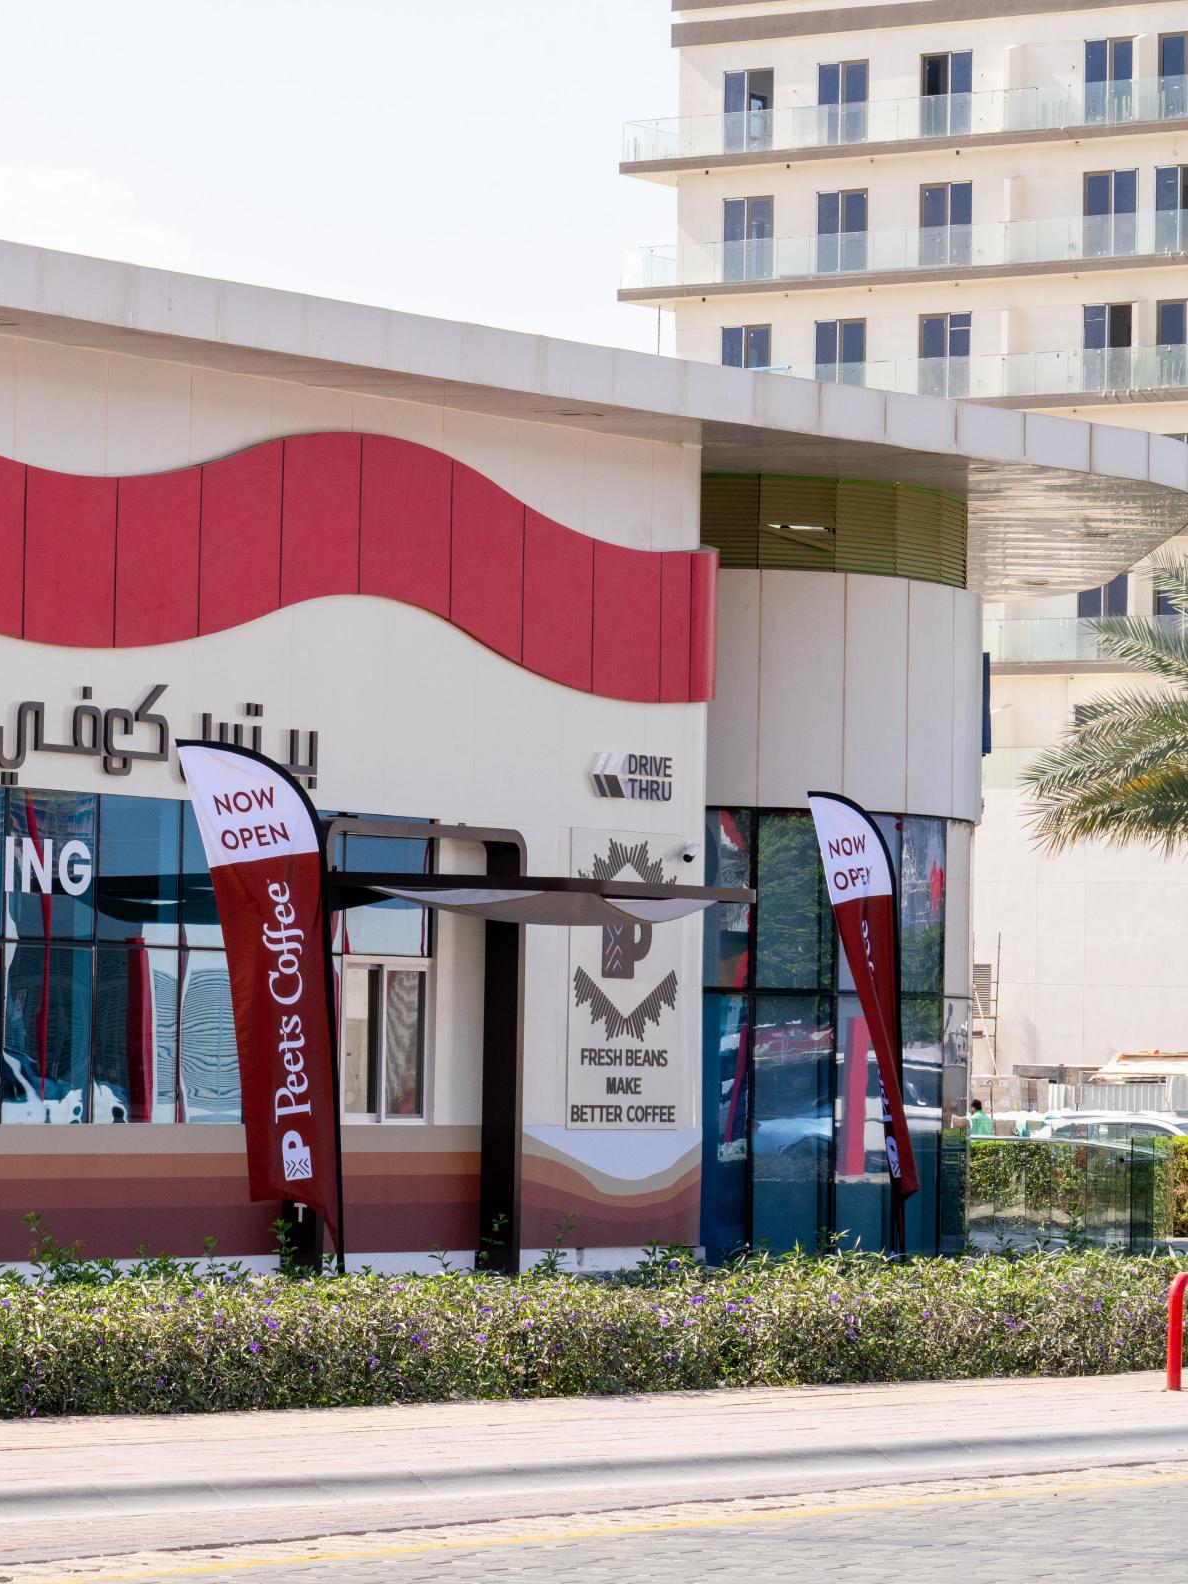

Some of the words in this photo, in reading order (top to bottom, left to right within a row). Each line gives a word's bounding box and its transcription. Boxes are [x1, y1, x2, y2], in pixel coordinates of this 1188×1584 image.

[627, 753, 672, 778] DRIVE
[213, 786, 274, 815] NOW
[627, 778, 672, 802] THRU
[221, 822, 291, 850] OPEN
[828, 834, 866, 859] NOW
[262, 880, 305, 1006] Coffee
[580, 1047, 623, 1066] FRESH
[625, 1049, 668, 1067] BEANS
[606, 1076, 642, 1095] MAKE
[570, 1104, 623, 1123] BETTER
[626, 1105, 676, 1123] COFFEE
